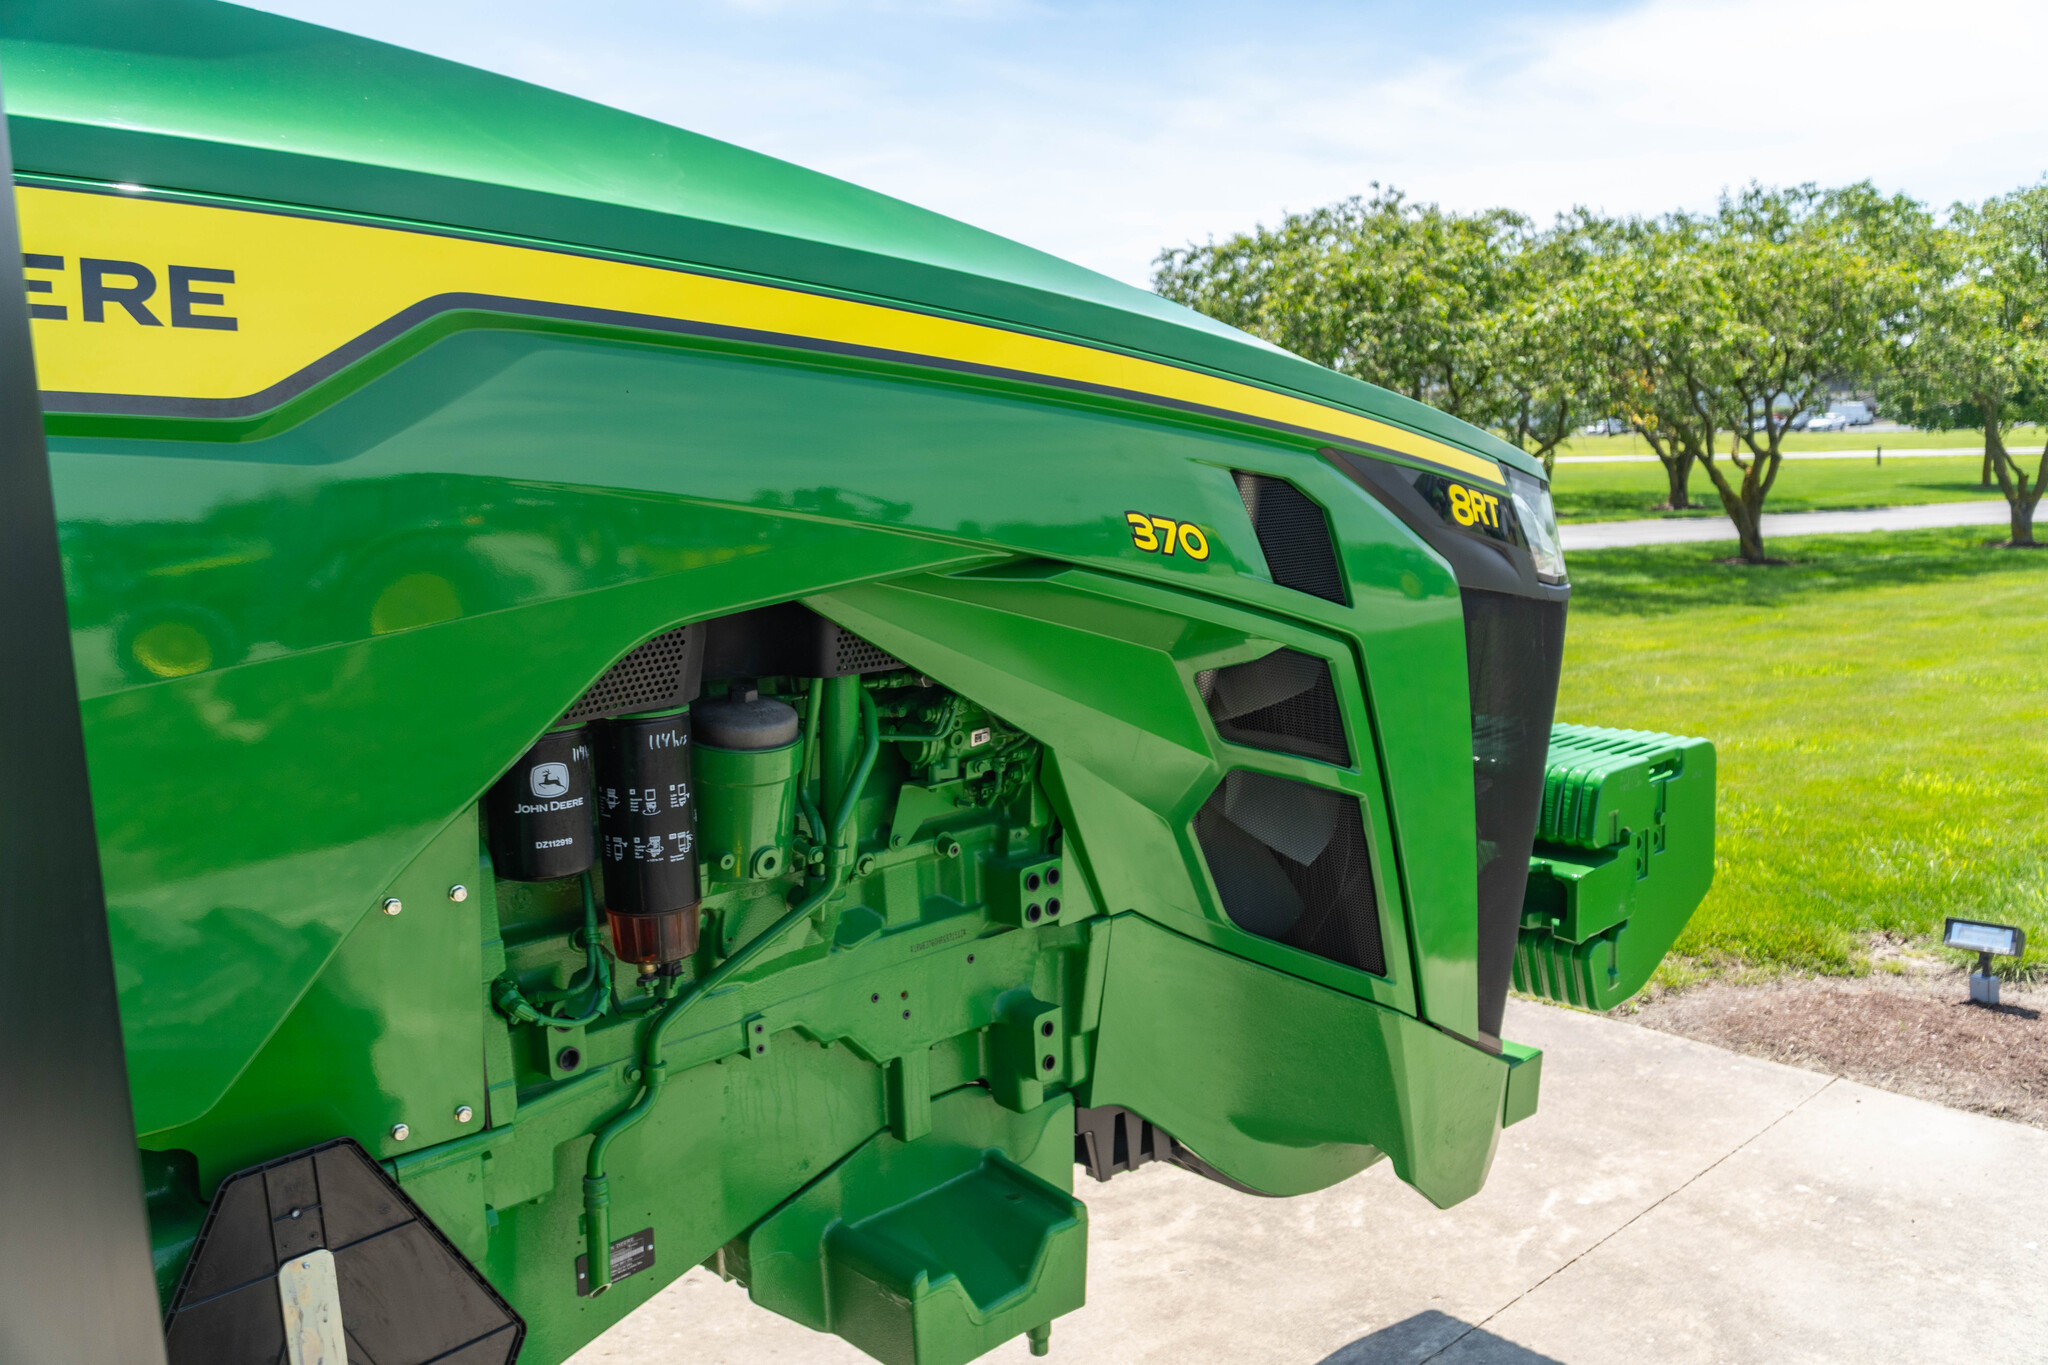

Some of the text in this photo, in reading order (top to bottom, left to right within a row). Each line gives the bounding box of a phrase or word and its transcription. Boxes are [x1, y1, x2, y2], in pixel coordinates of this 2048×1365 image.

[20, 252, 239, 332] ERE
[1448, 483, 1499, 529] 8RT
[1124, 510, 1210, 562] 370
[514, 803, 548, 814] JOHN
[549, 796, 584, 812] DEERE
[535, 837, 573, 849] DZ112919
